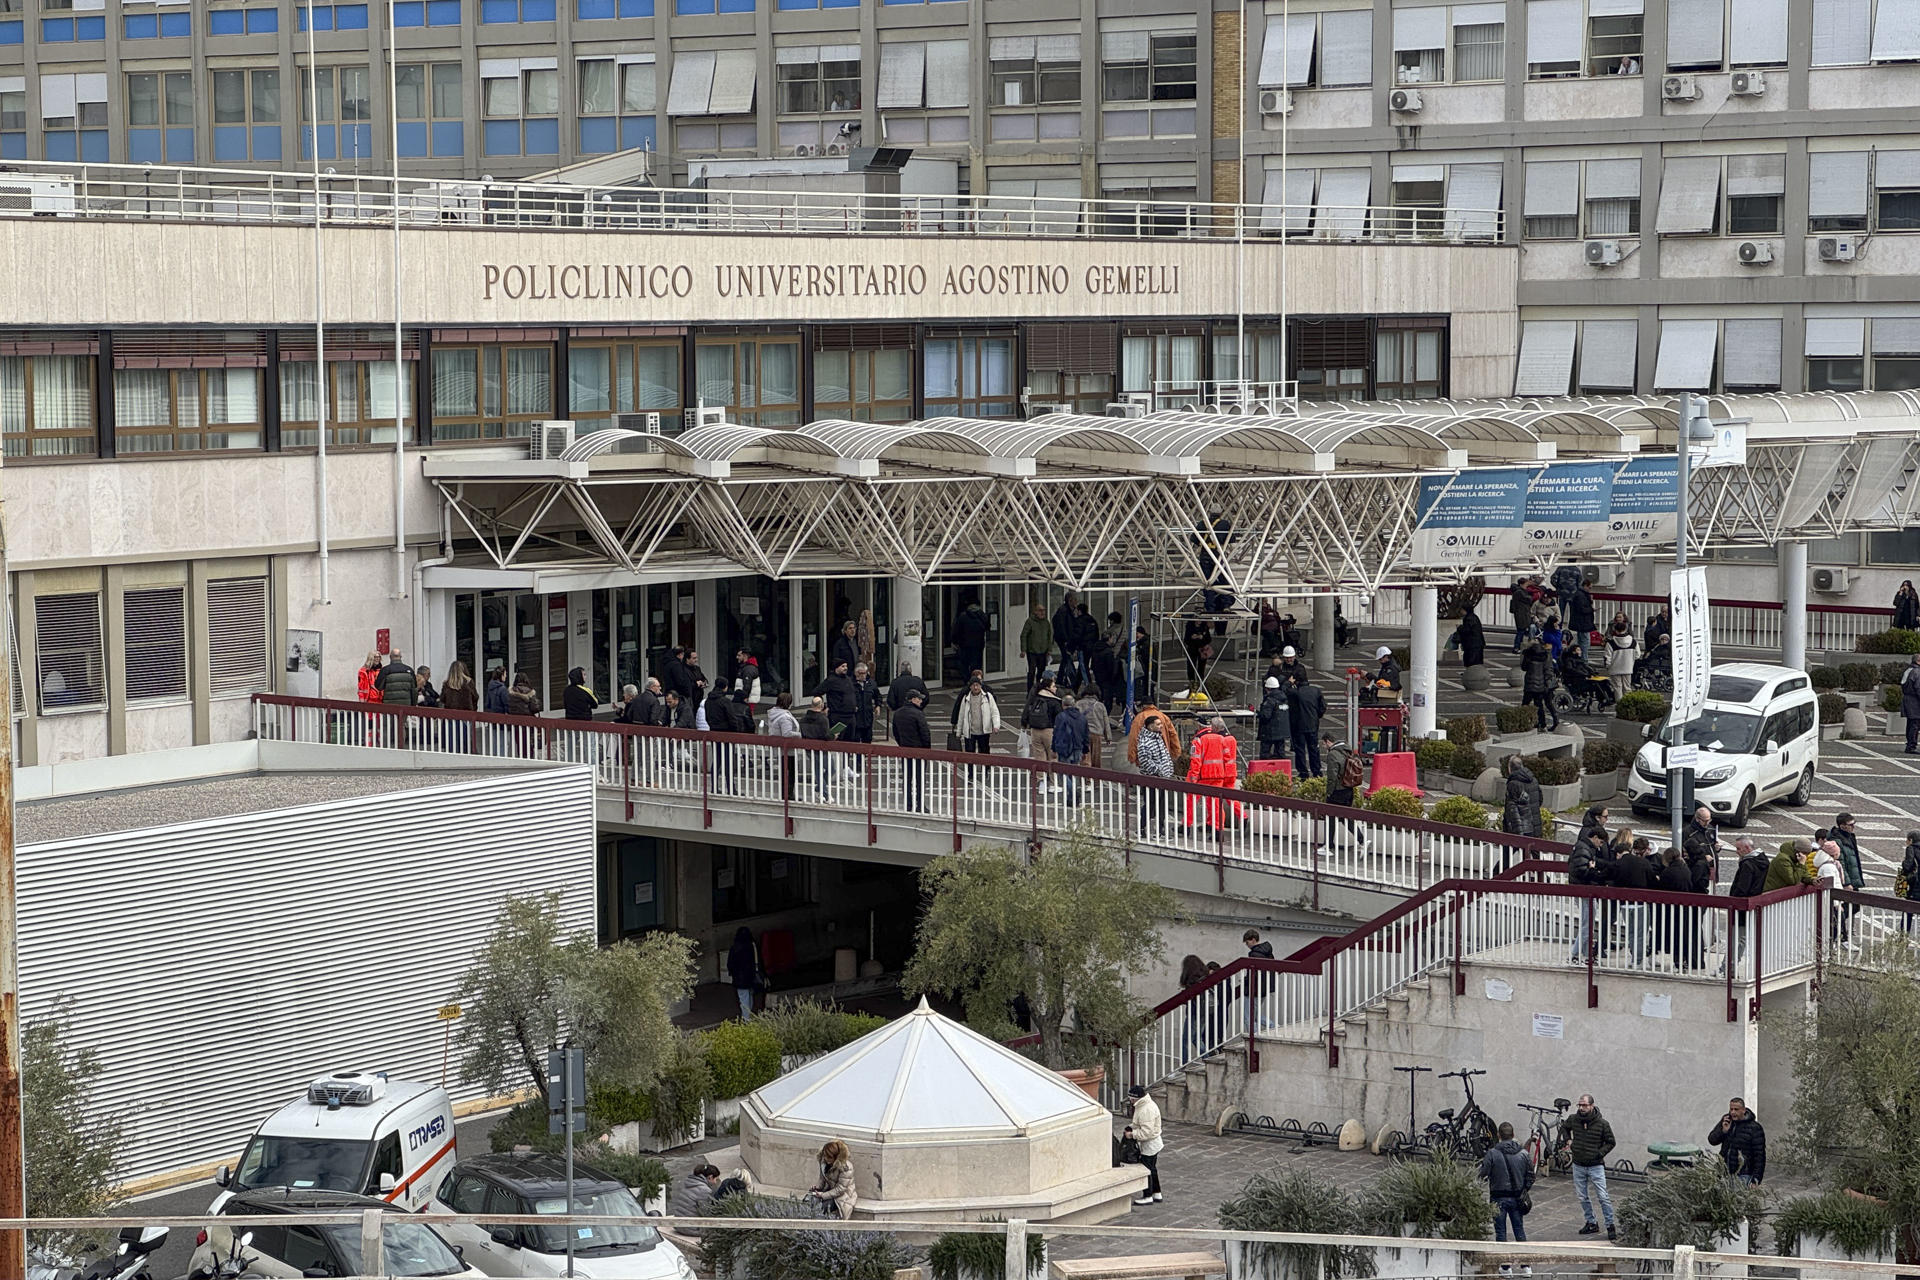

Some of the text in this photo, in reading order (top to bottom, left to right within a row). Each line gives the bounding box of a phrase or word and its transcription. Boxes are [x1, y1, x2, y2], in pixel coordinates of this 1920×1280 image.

[482, 264, 1180, 300] POLICLINICO UNIVERSITARIO AGOSTINO GEMELLI
[1440, 550, 1472, 558] Gemelli
[1606, 533, 1636, 541] Gemelli
[1674, 632, 1684, 711] Gemelli
[1691, 628, 1702, 706] Gemelli
